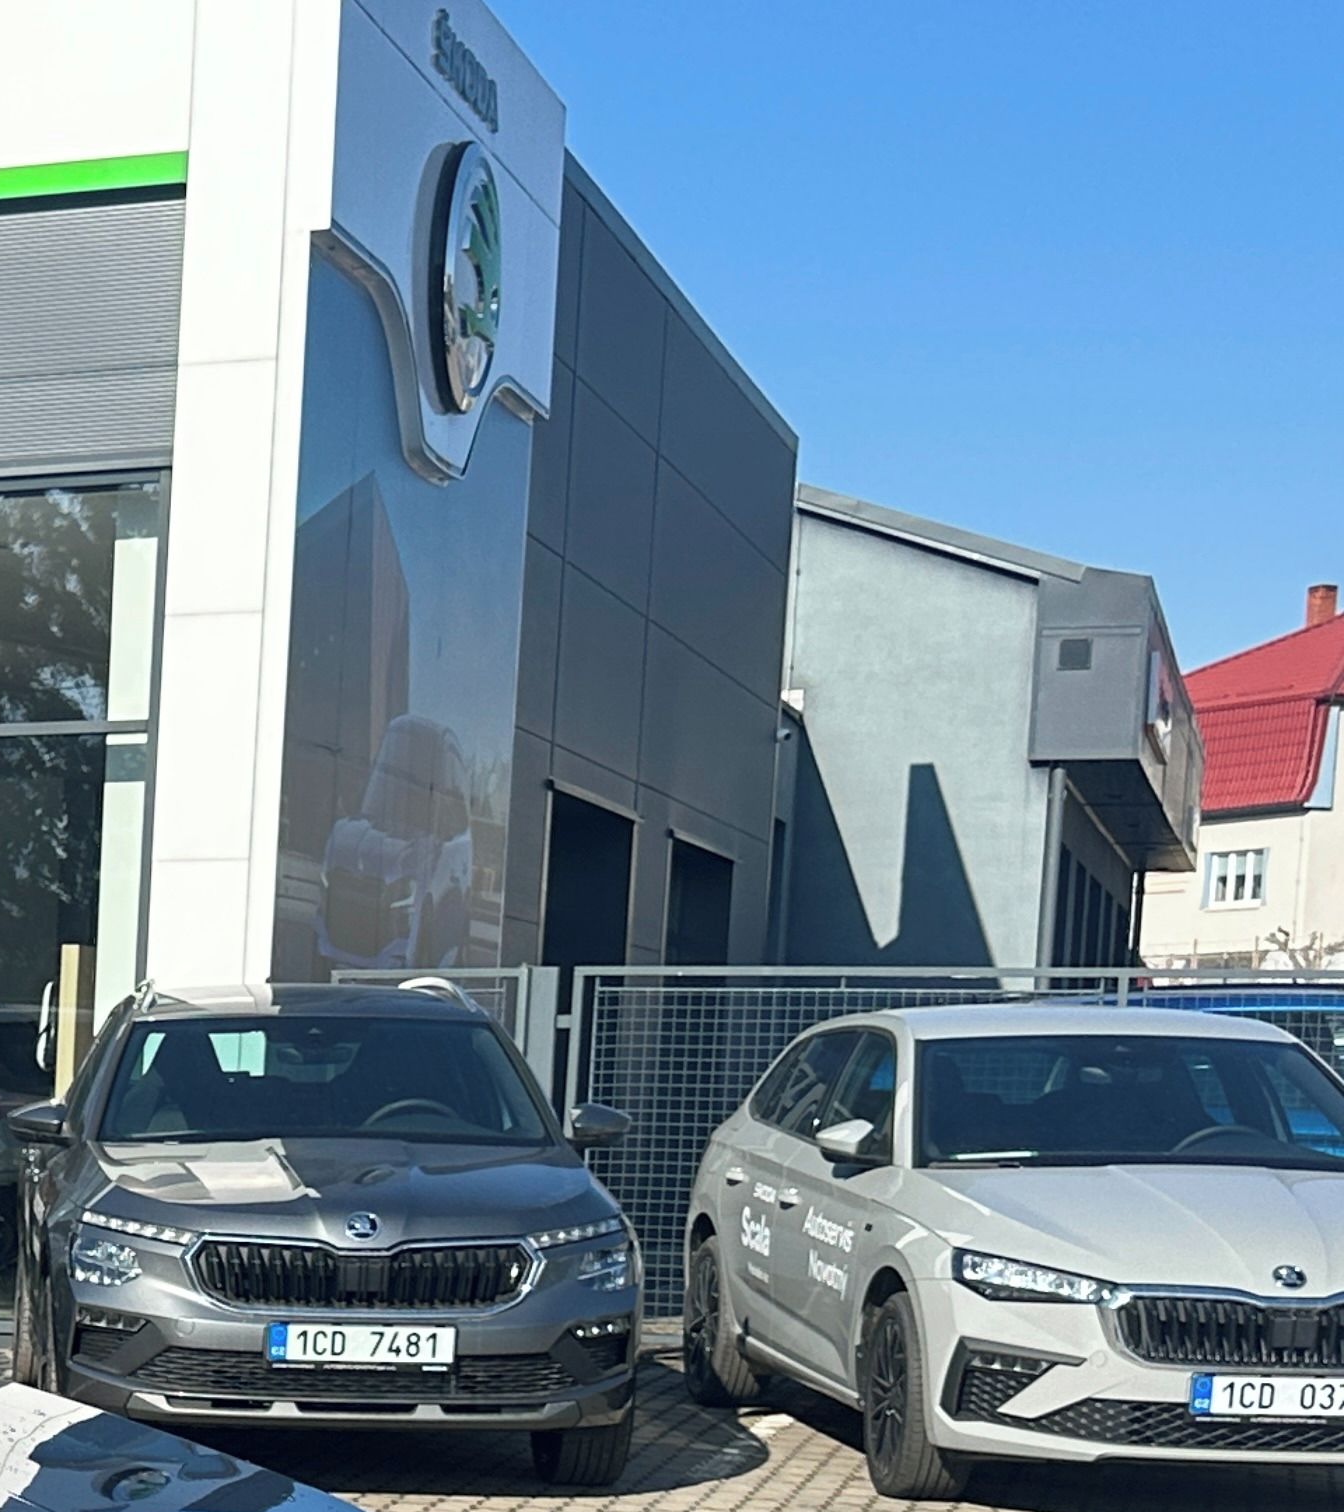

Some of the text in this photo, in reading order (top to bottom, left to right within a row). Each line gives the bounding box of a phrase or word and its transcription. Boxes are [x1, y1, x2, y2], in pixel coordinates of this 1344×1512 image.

[740, 1206, 771, 1257] Scala
[801, 1205, 855, 1254] Autoservis
[807, 1248, 849, 1302] Novotný
[296, 1329, 347, 1356] 1CD
[369, 1330, 439, 1359] 7481
[1222, 1381, 1276, 1409] 1CD
